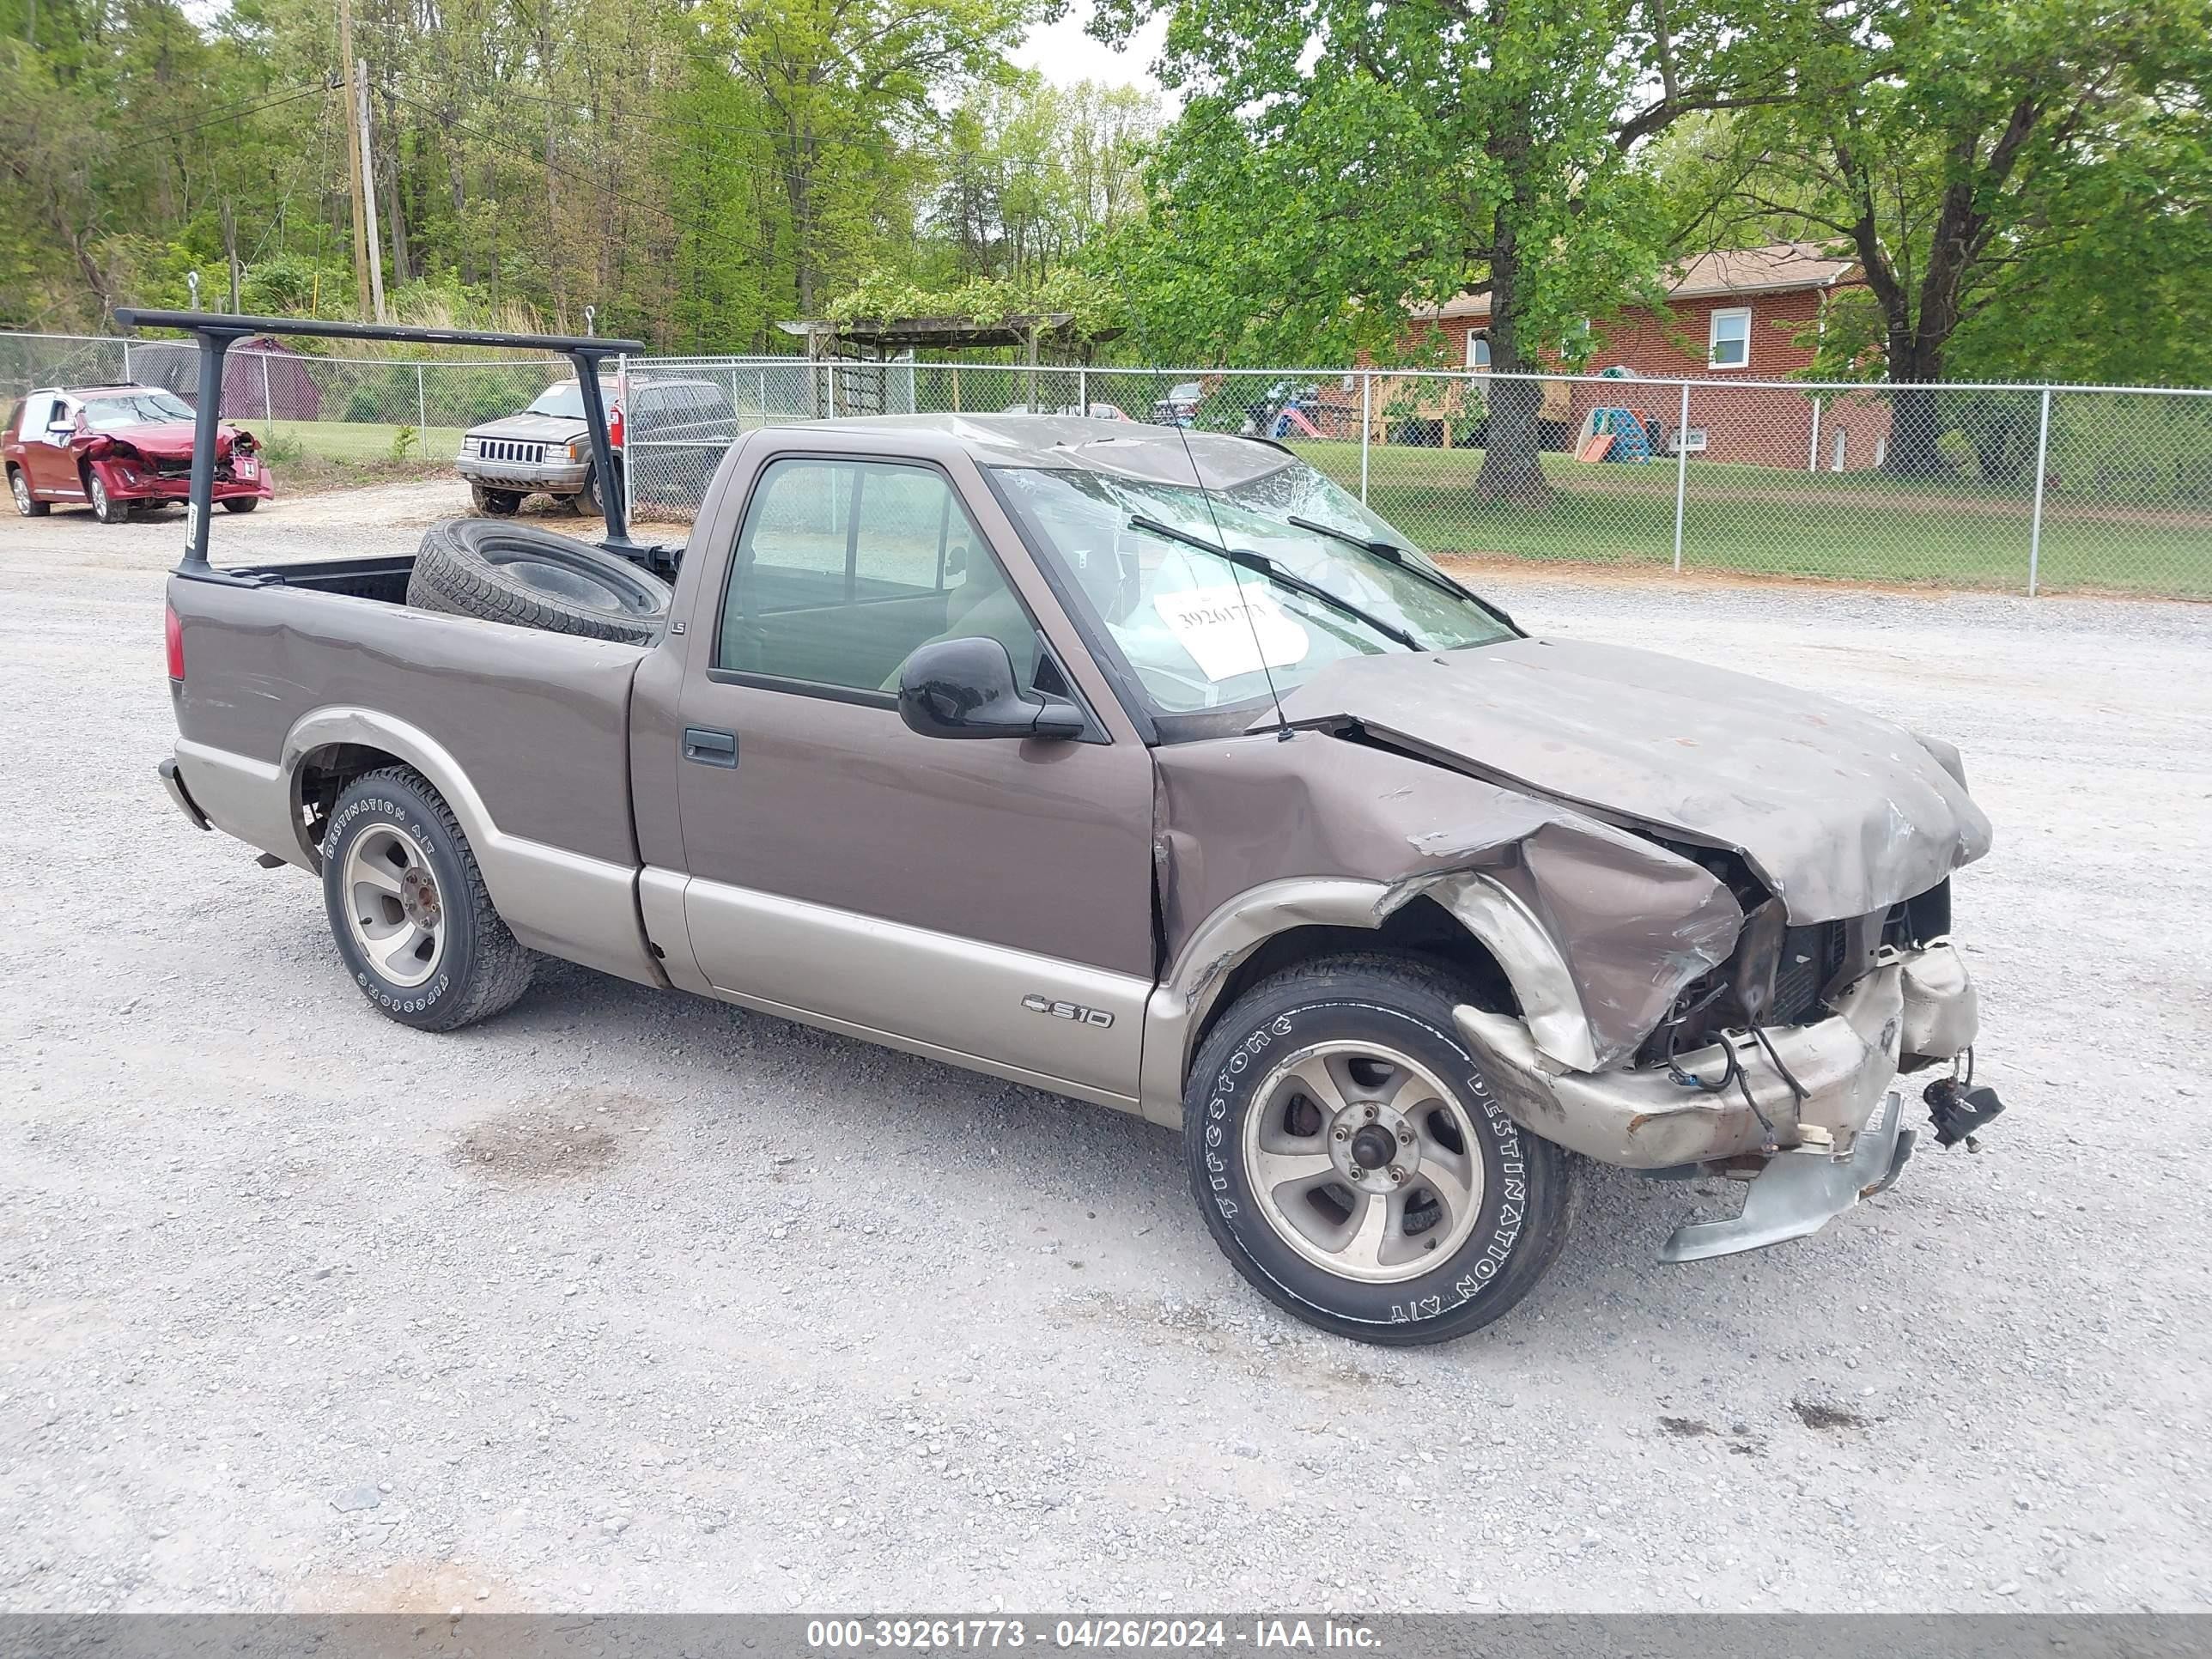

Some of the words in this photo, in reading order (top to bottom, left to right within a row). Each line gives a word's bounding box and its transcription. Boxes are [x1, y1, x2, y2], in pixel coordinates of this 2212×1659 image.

[671, 622, 685, 634] LS
[325, 798, 406, 860] DESTINATION
[411, 824, 435, 854] A/T
[1052, 1001, 1115, 1028] S10
[1455, 1075, 1526, 1299] DESTINATION
[1391, 1294, 1441, 1324] A/T
